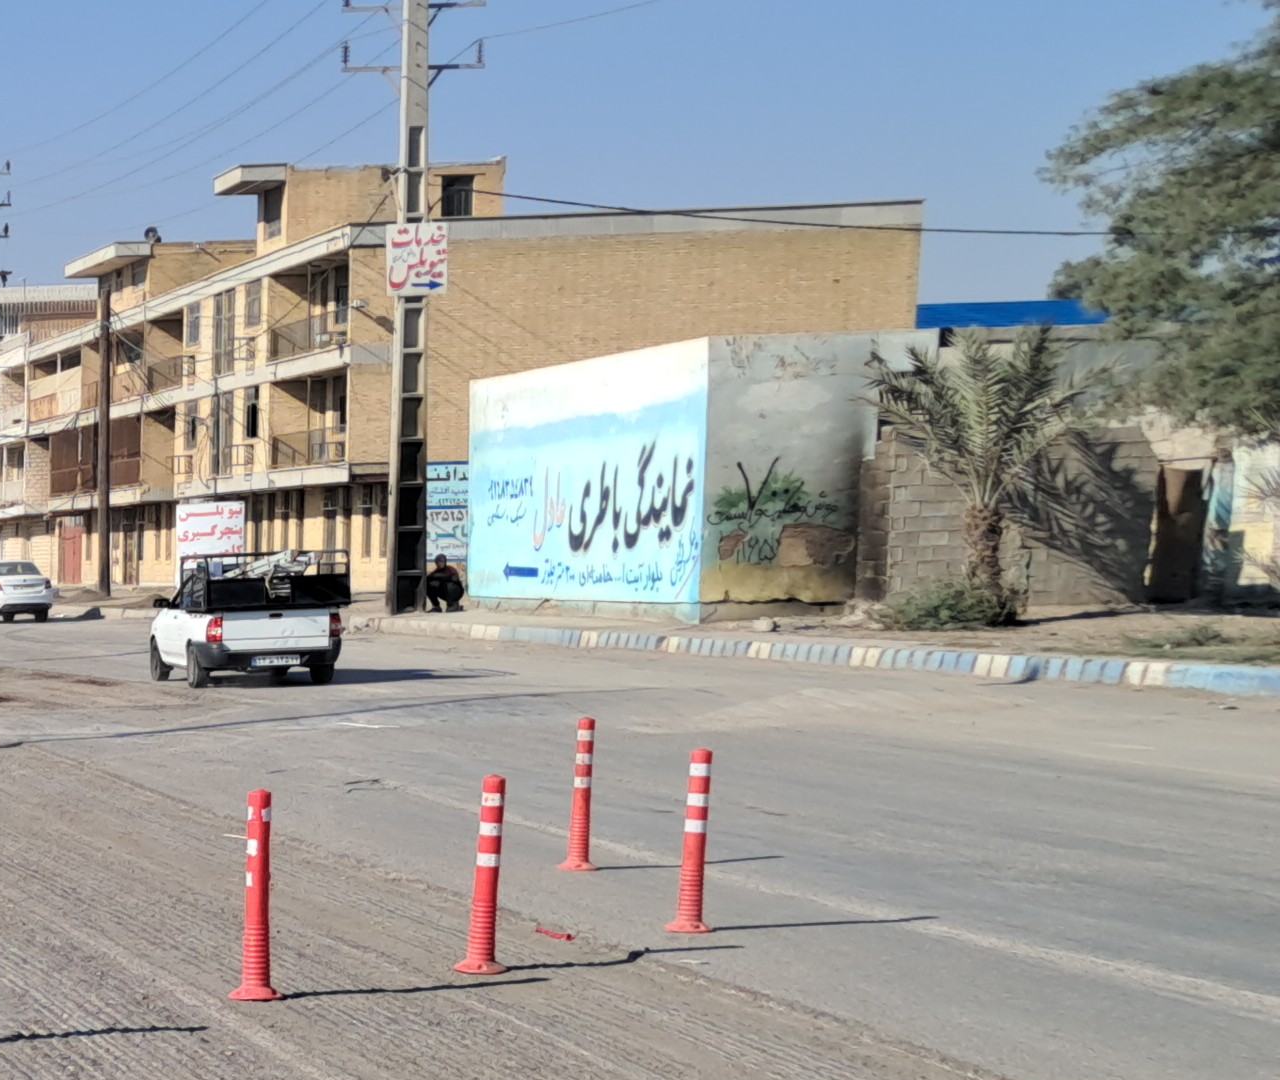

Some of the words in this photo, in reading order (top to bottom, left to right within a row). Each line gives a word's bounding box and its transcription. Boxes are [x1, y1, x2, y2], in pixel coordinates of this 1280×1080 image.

[392, 223, 446, 249] خدمات
[568, 460, 621, 555] باطری
[623, 440, 695, 550] نمایندگی
